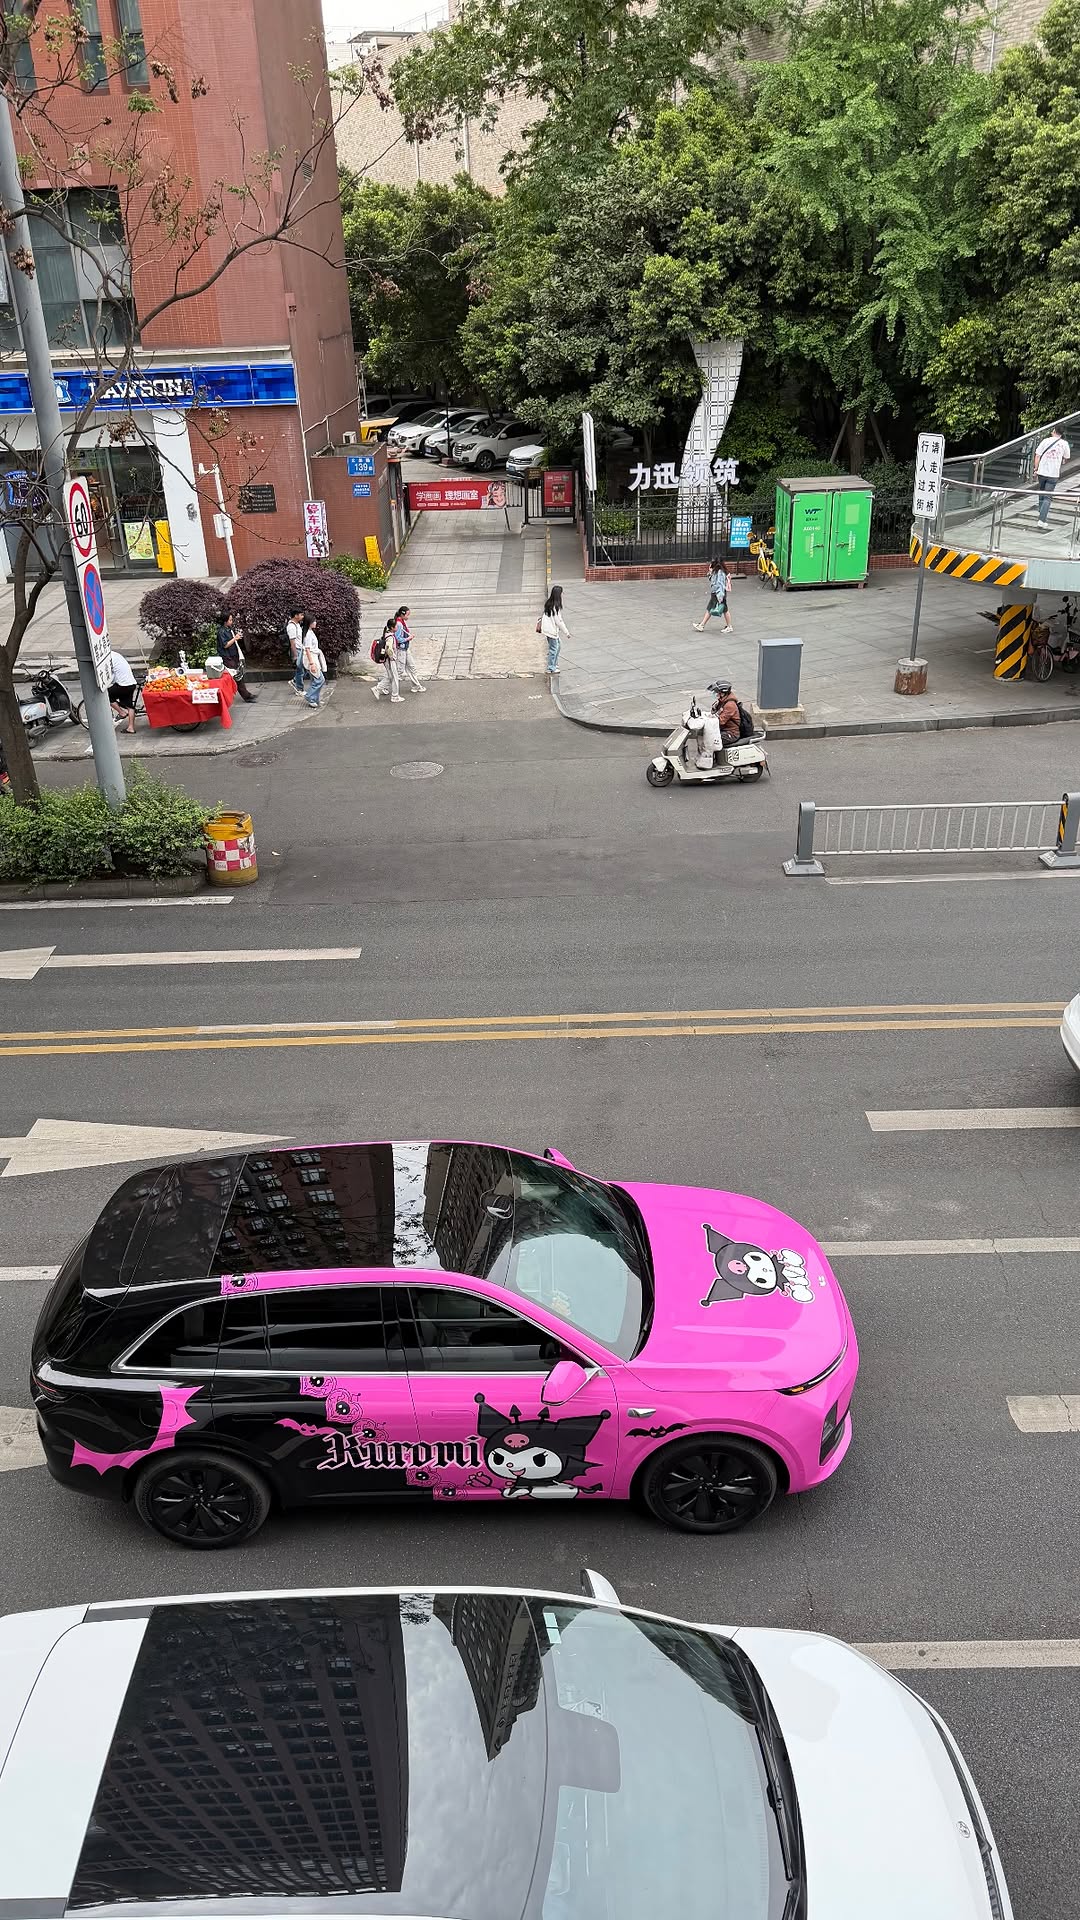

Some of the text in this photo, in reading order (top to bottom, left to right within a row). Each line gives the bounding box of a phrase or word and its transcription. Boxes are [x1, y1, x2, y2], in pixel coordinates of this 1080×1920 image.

[88, 379, 184, 399] LAWSON
[628, 457, 740, 491] 力迅领筑
[916, 440, 930, 511] 行人过街
[926, 441, 940, 513] 请走天桥
[445, 489, 479, 501] 理想画室
[75, 502, 88, 536] 60
[317, 1431, 483, 1470] Kuromi
